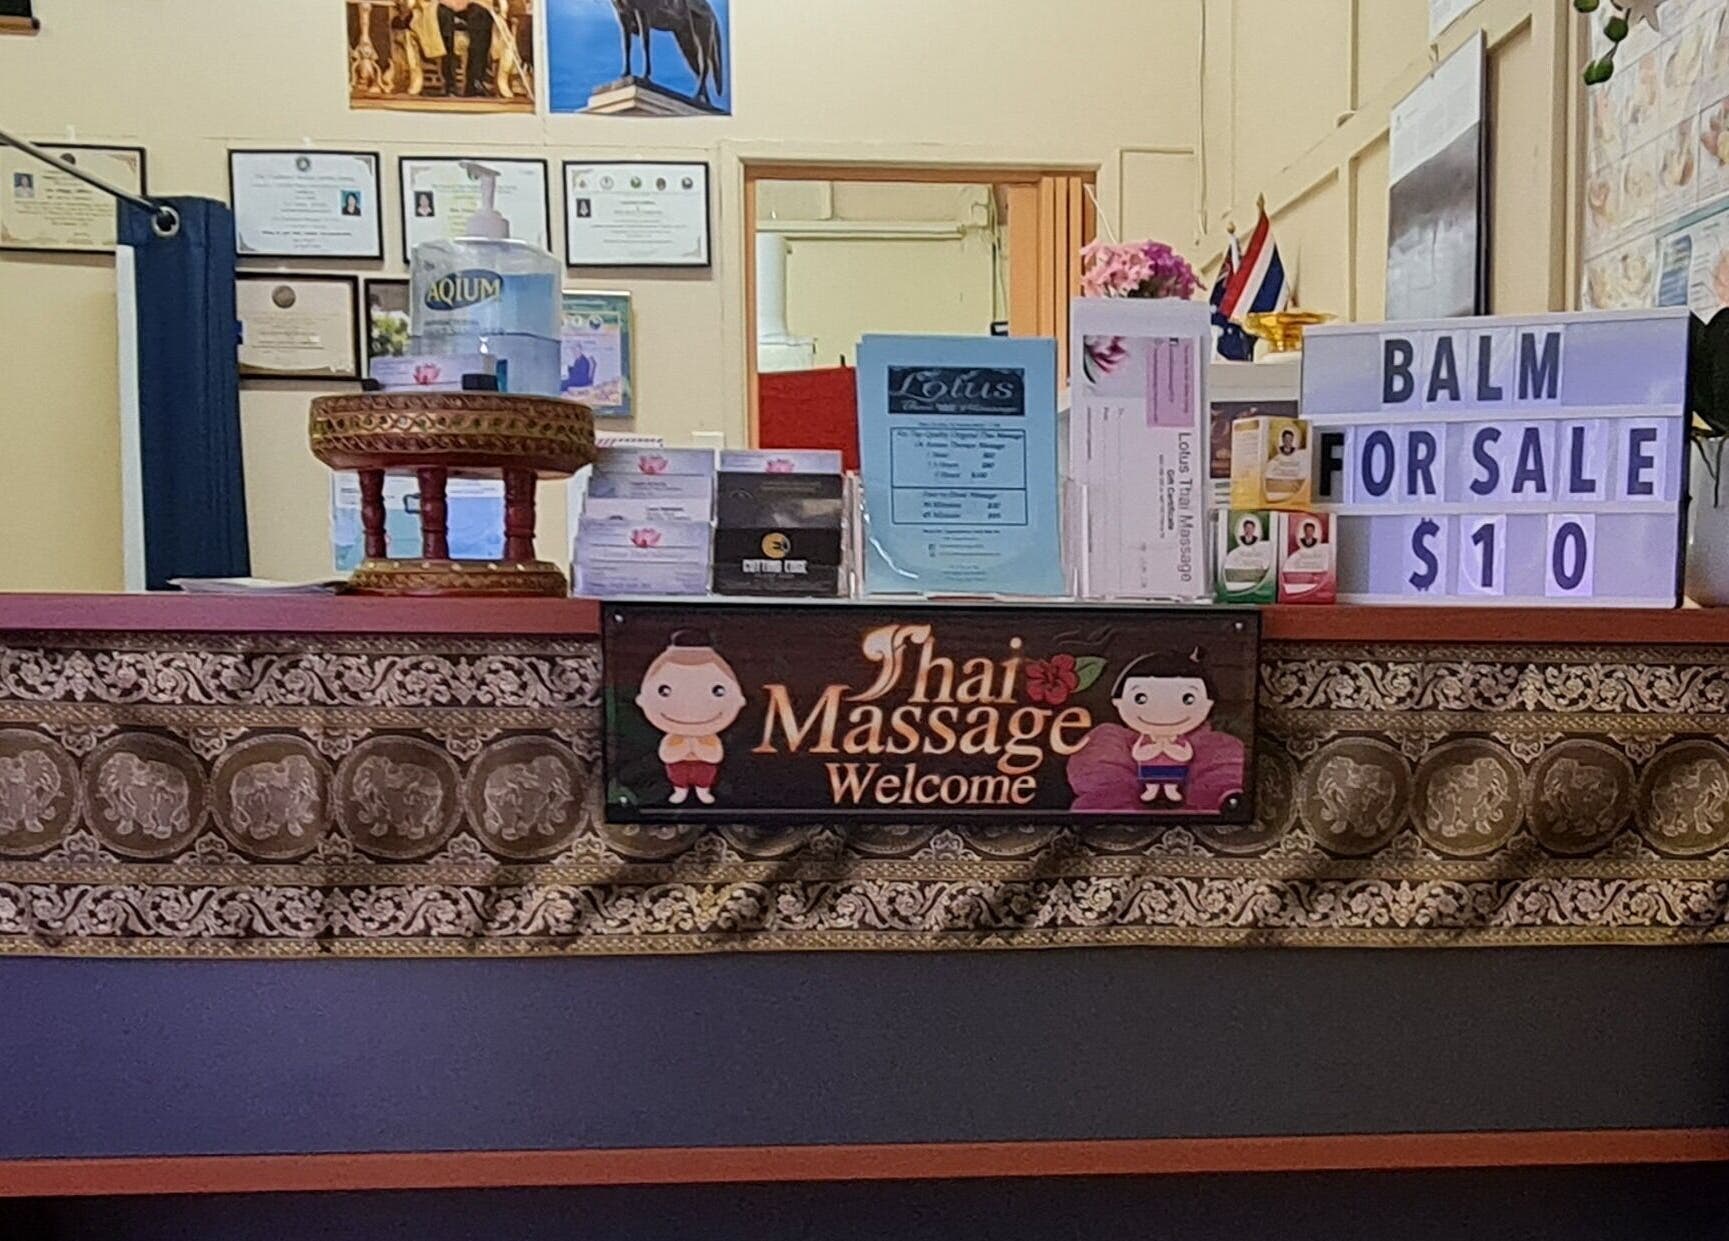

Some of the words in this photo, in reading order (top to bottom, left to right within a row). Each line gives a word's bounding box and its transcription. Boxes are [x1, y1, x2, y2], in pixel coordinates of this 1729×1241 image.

[427, 277, 501, 306] AQIUM
[893, 370, 1015, 402] Lotus
[1382, 332, 1561, 403] BALM
[1178, 432, 1192, 473] Lotus
[1319, 429, 1437, 497] FOR
[1469, 426, 1658, 496] SALE
[1178, 478, 1193, 510] Thai
[1177, 514, 1194, 583] Massage
[845, 623, 1022, 704] Thai
[752, 684, 1092, 774] Massage
[825, 762, 1037, 805] Welcome
